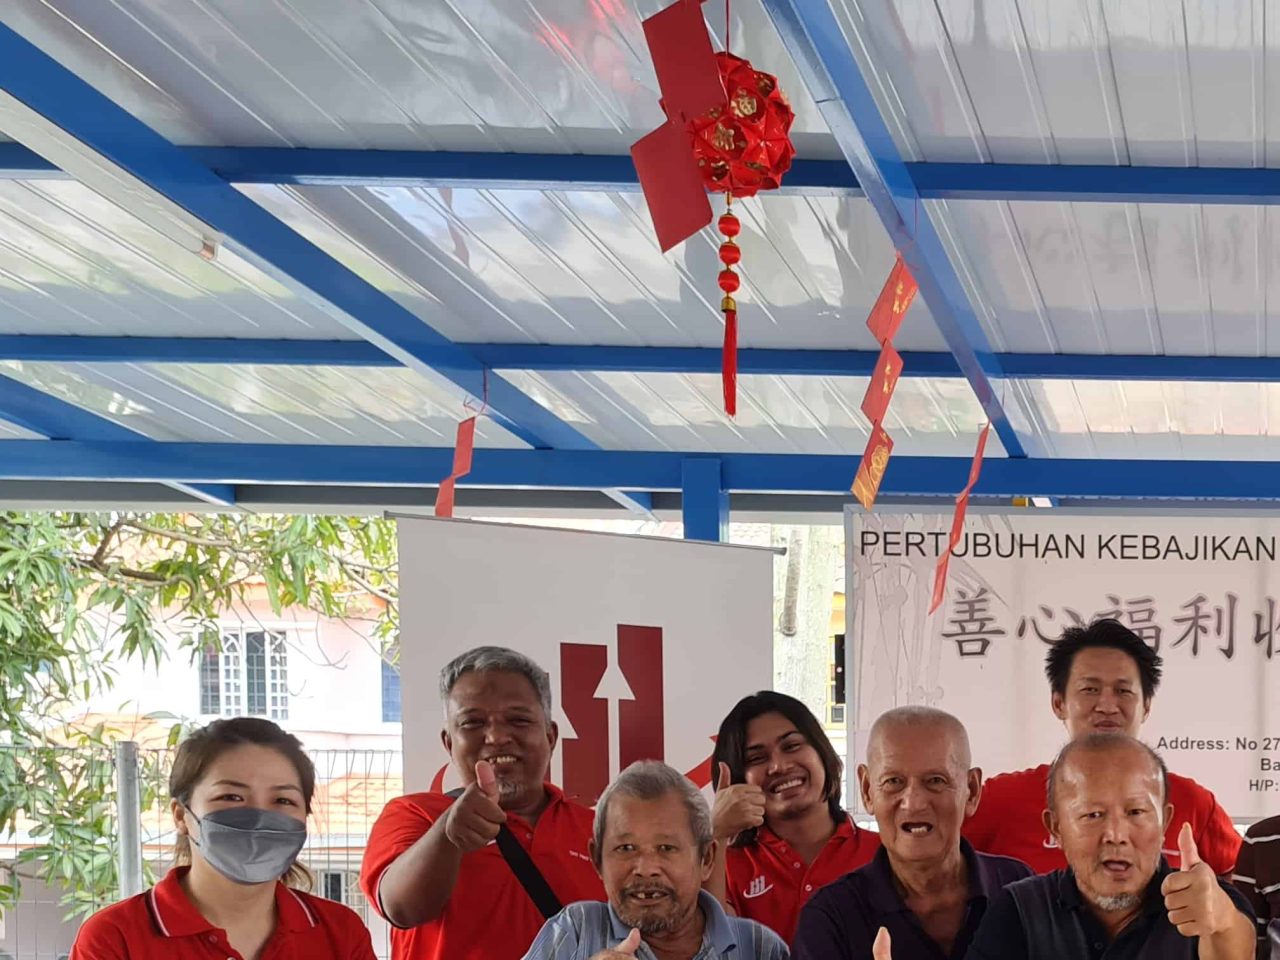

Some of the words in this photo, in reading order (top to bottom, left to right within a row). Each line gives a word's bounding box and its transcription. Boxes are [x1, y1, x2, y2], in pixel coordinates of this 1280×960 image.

[860, 530, 1085, 560] PERTUBUHAN
[1098, 534, 1276, 561] KEBAJIKAN
[1157, 737, 1229, 750] Address:
[1236, 737, 1257, 750] No
[1249, 780, 1279, 792] H/P:
